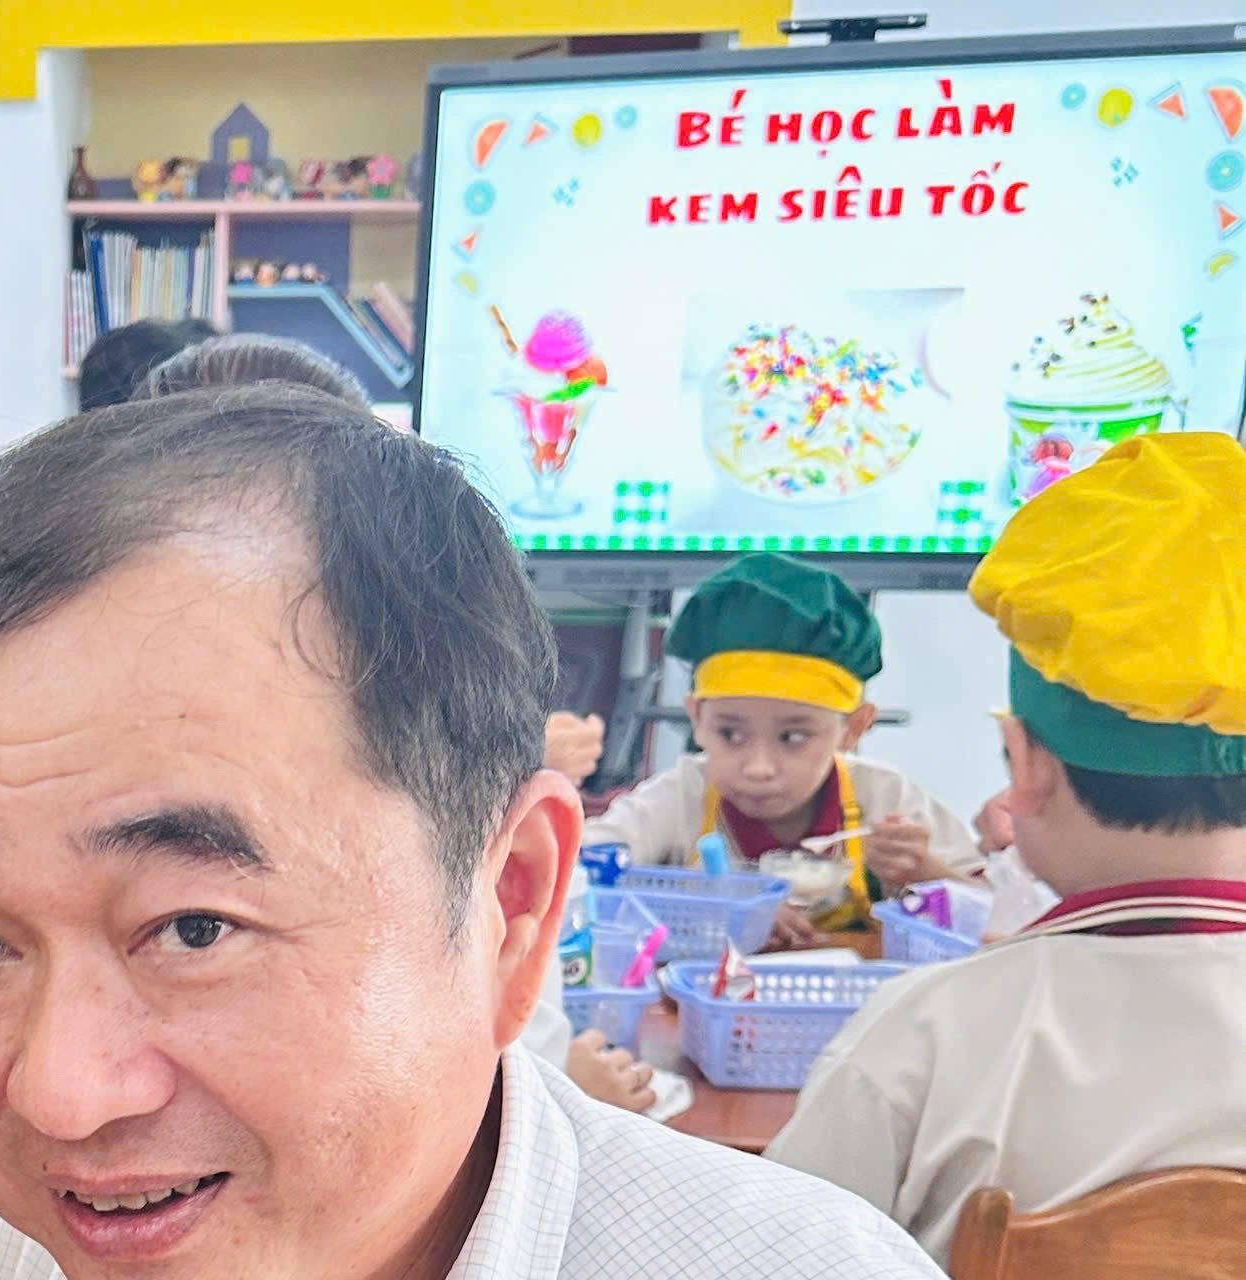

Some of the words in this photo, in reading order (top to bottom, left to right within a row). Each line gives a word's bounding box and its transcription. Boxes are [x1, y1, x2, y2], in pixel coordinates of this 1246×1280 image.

[676, 88, 747, 149] BÉ
[765, 108, 877, 159] HỌC
[895, 79, 1016, 140] LÀM
[647, 191, 759, 226] KEM
[777, 164, 905, 223] SIÊU
[926, 161, 1030, 217] TỐC
